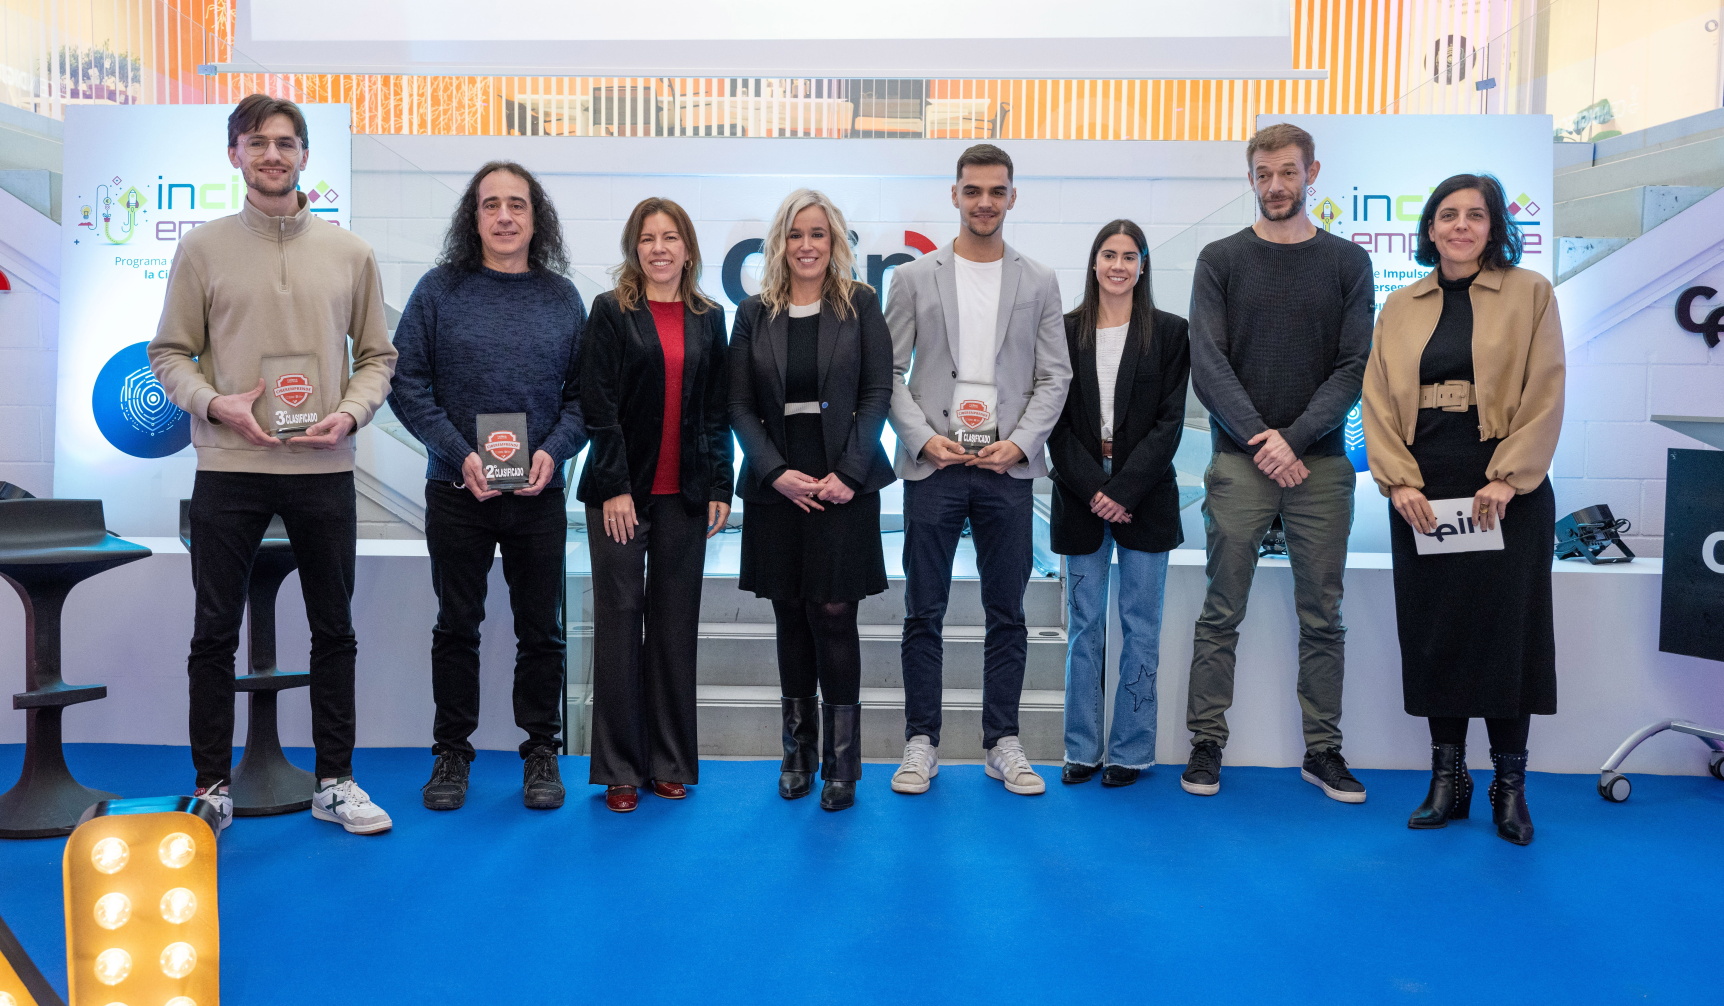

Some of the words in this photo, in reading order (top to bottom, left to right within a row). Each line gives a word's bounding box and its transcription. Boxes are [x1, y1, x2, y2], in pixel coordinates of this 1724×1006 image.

[157, 175, 248, 210] inci
[115, 256, 167, 269] Programa
[144, 269, 155, 280] la
[286, 413, 317, 424] CLASIFICADO
[964, 433, 990, 444] CLASIFICADO
[495, 467, 523, 477] CLASIFICADO
